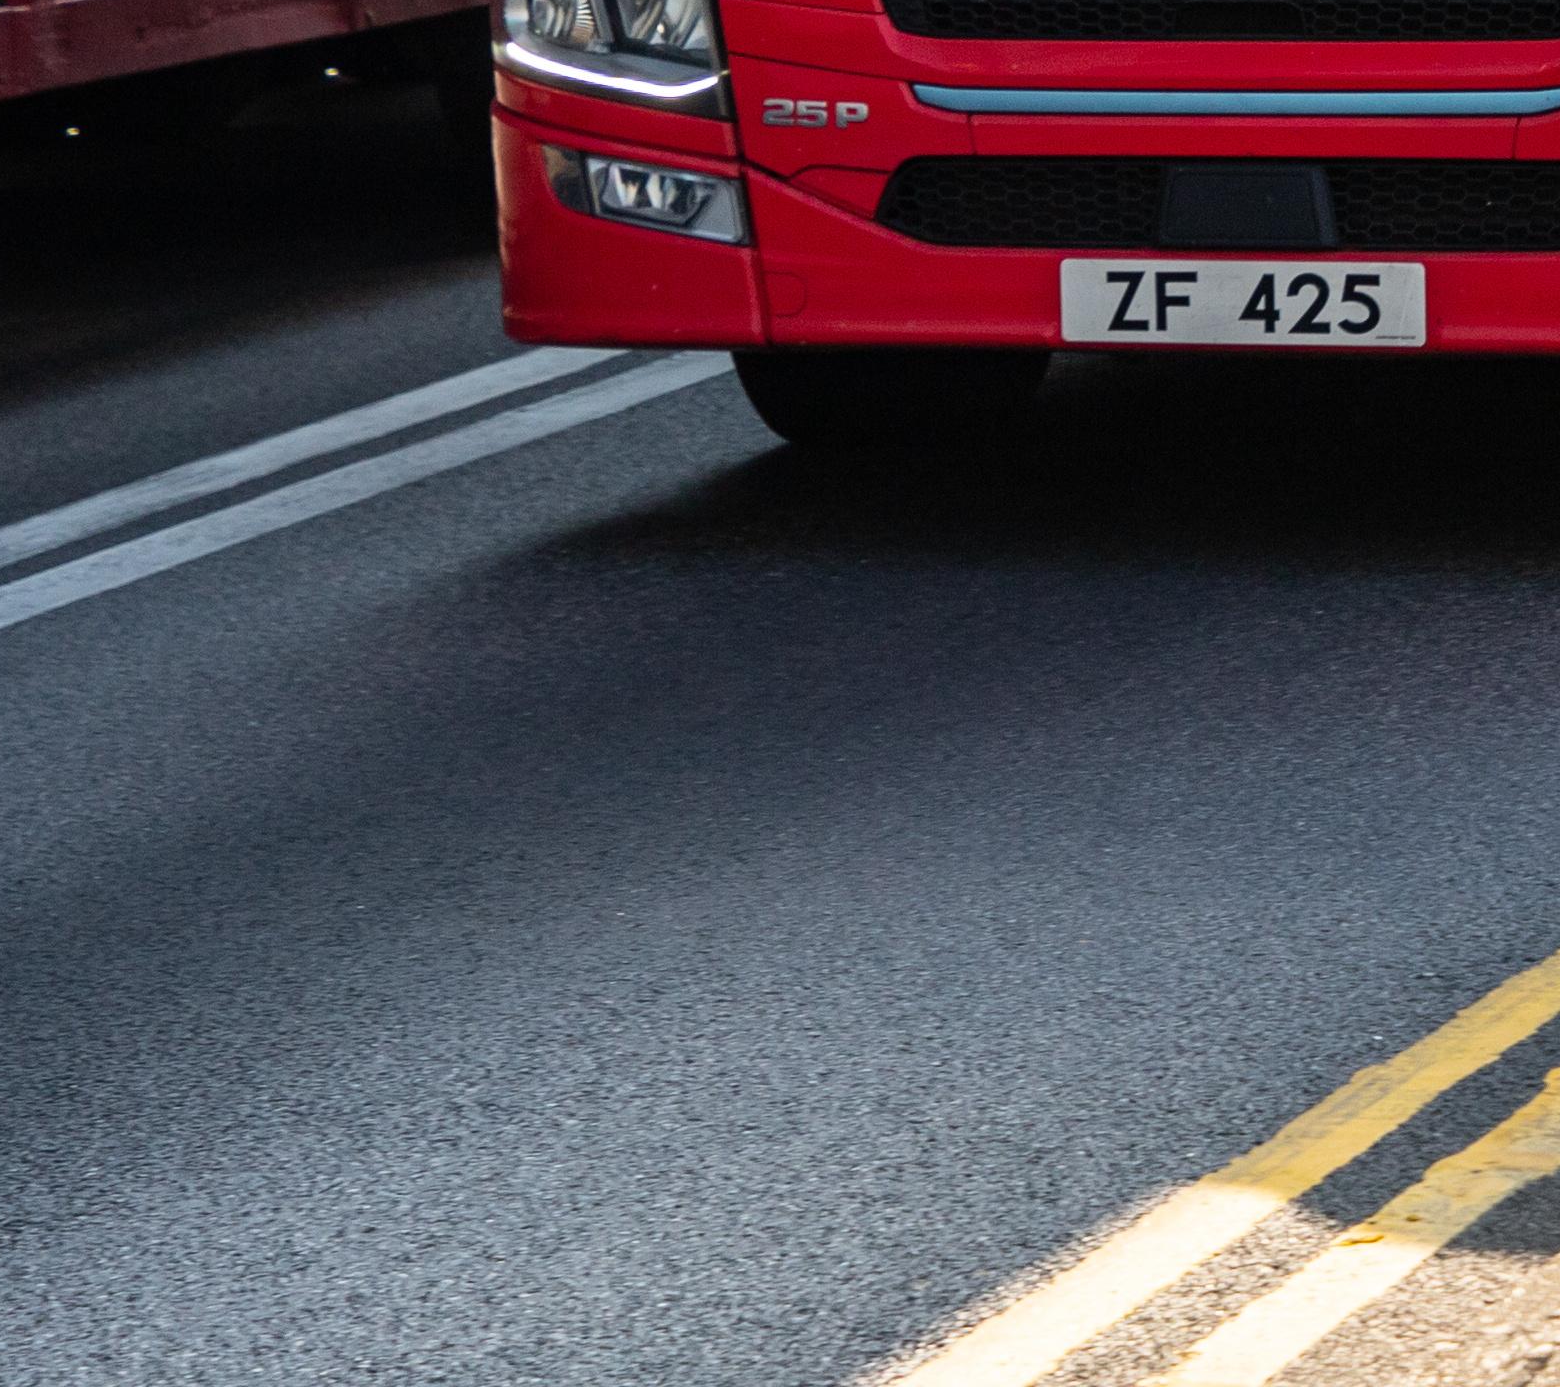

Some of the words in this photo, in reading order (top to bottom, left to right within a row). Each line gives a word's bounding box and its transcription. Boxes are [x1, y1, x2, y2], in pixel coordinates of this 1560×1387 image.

[763, 98, 828, 127] 25
[835, 101, 869, 129] P
[1106, 271, 1198, 331] ZF
[1238, 272, 1381, 335] 425
